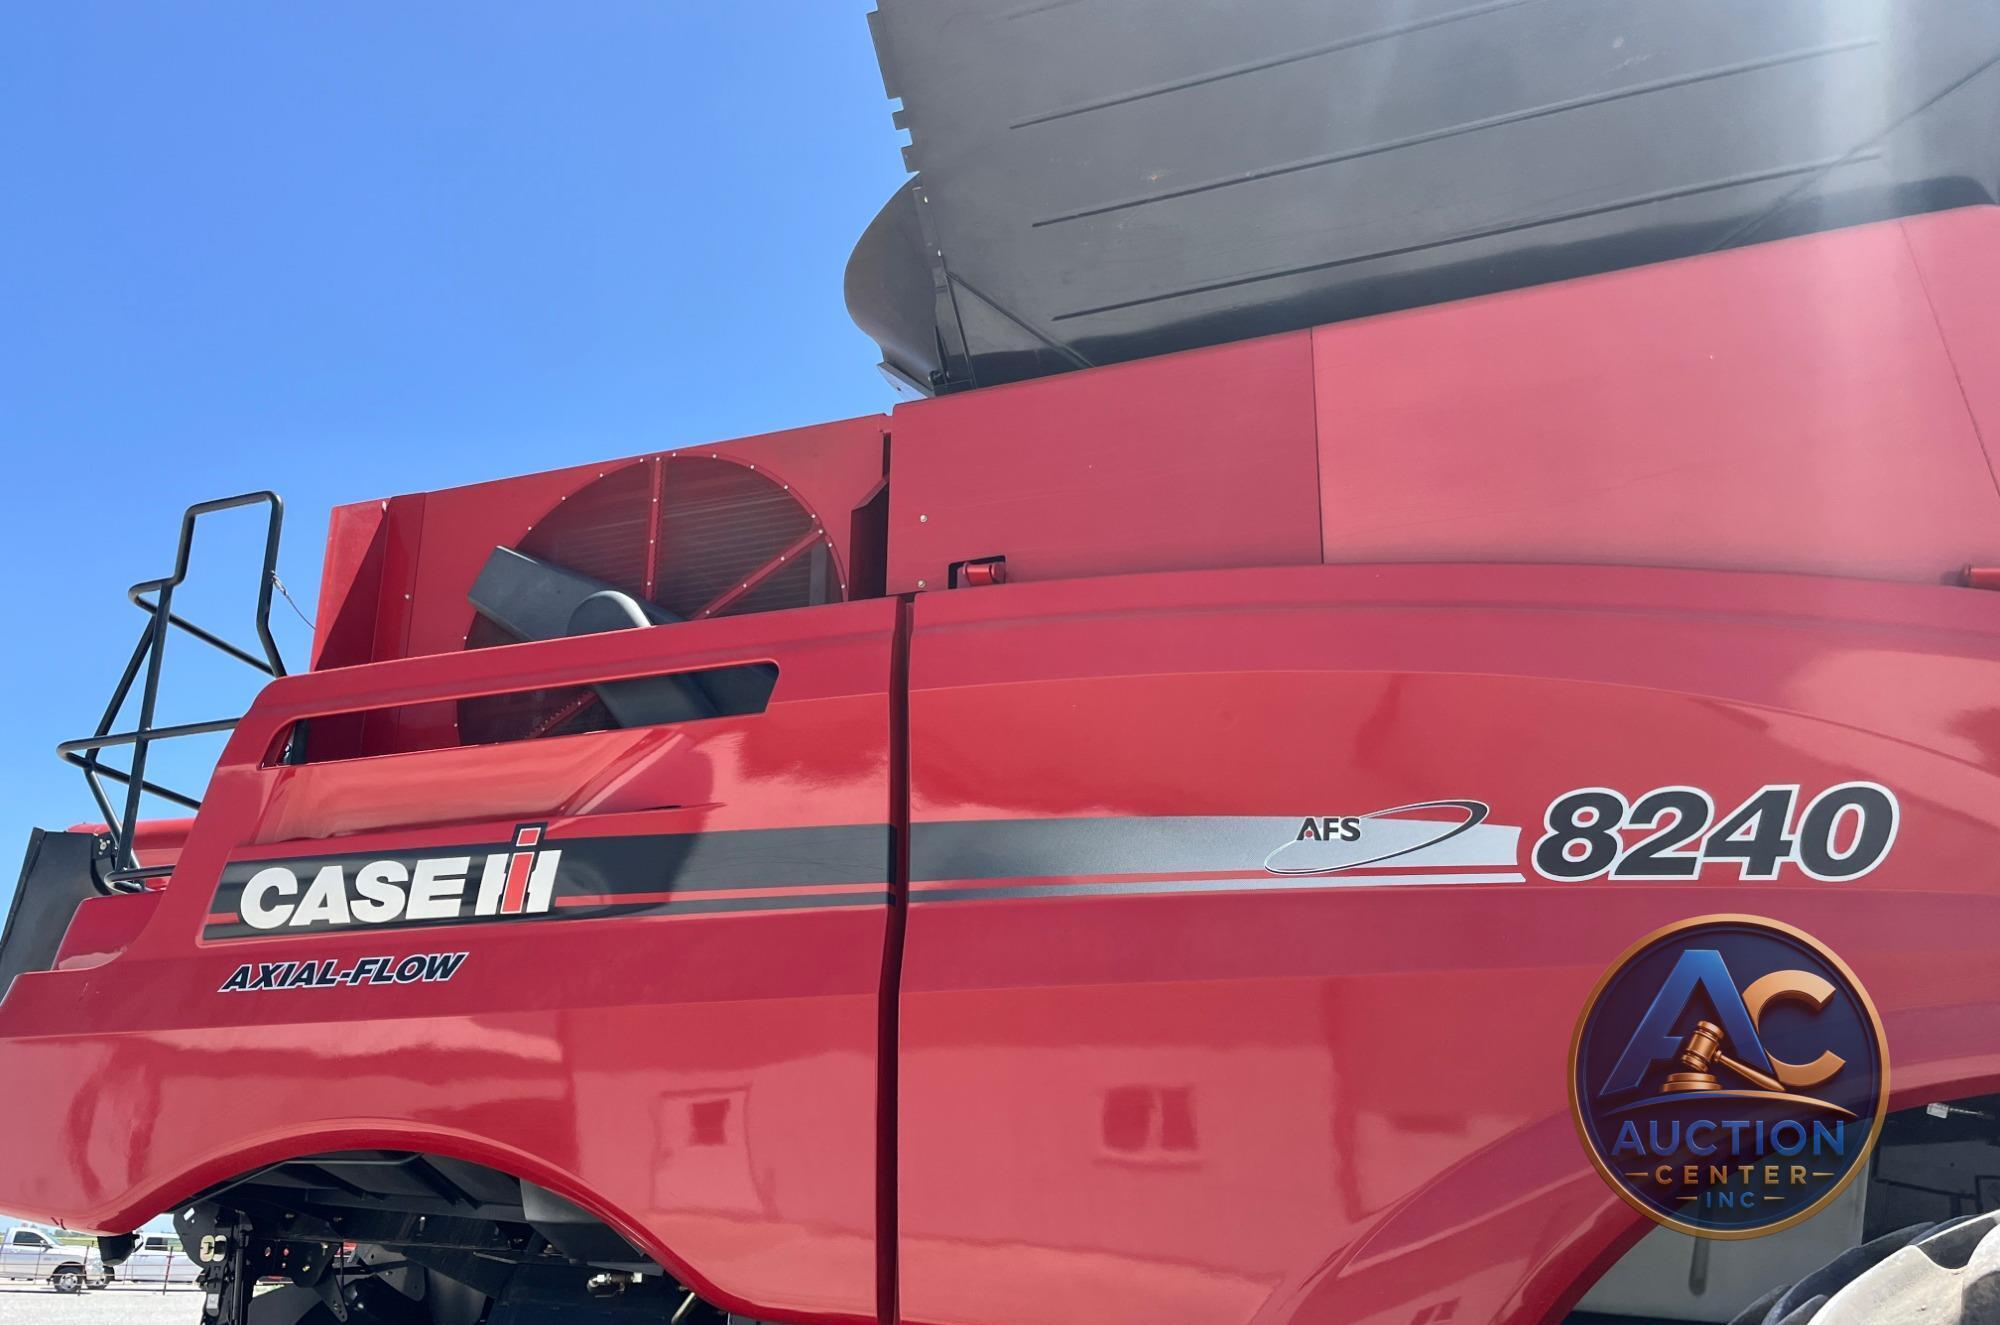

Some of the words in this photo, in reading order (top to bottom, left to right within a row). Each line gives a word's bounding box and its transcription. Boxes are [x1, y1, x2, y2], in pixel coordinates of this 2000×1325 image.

[1297, 817, 1361, 842] AFS
[1532, 781, 1900, 882] 8240
[239, 855, 470, 930] CASE
[218, 951, 470, 993] AXIAL-FLOW
